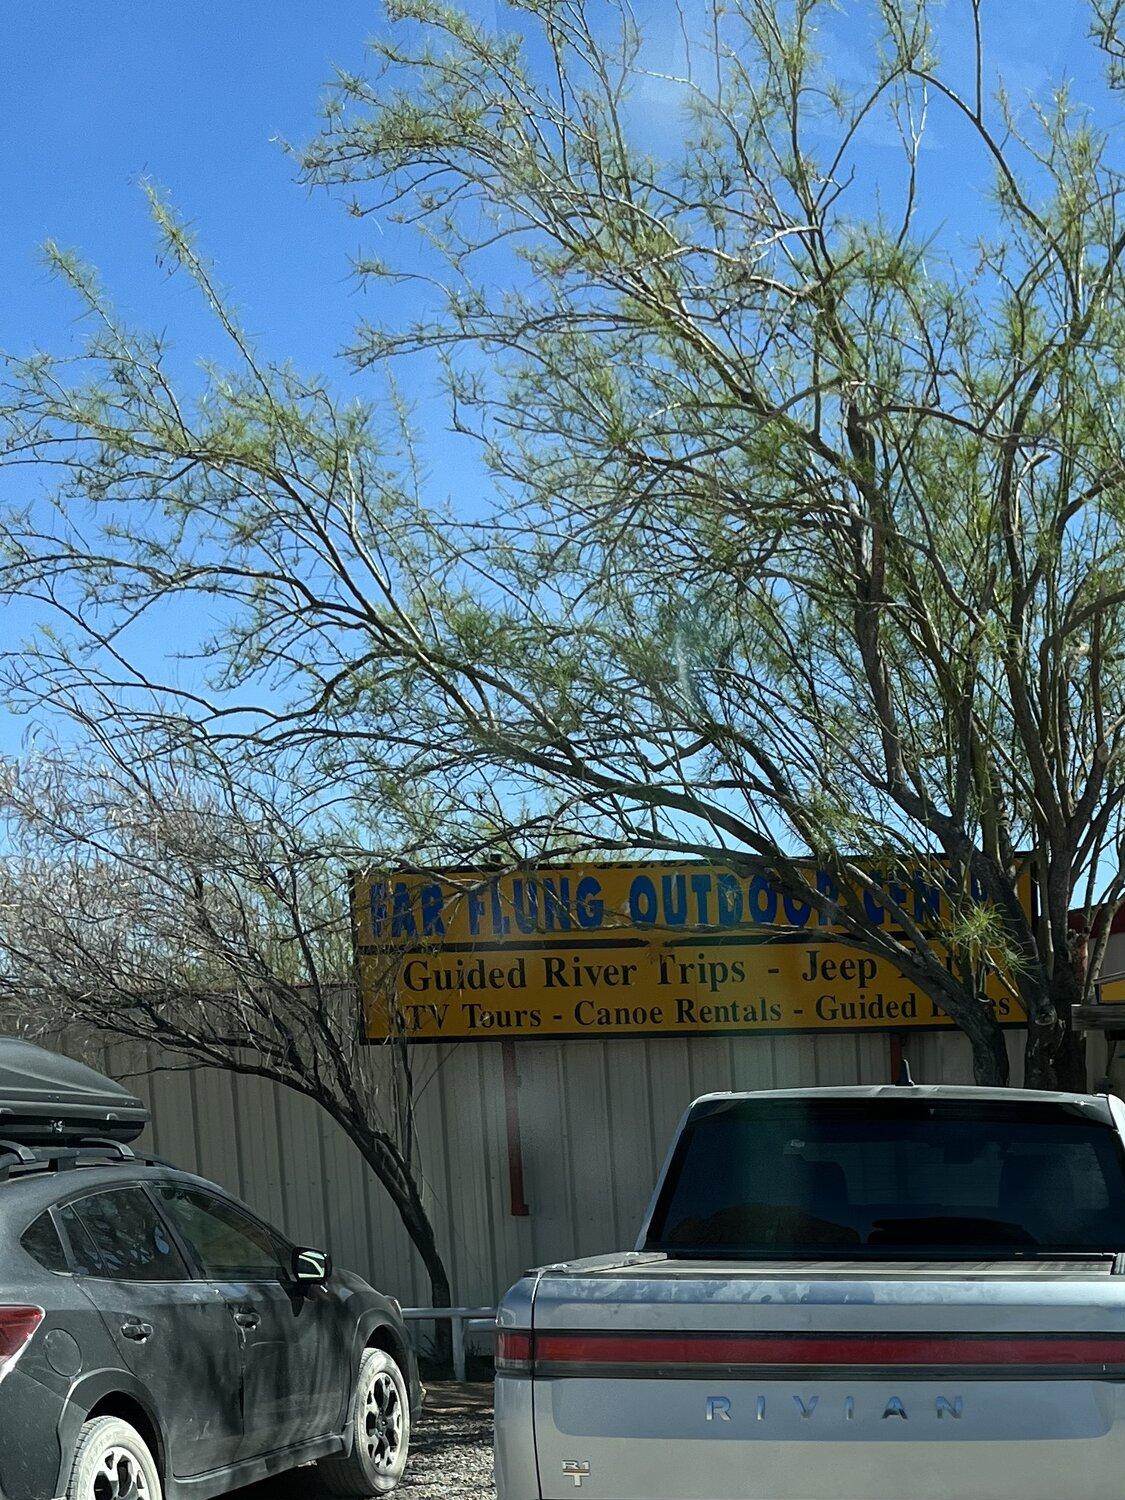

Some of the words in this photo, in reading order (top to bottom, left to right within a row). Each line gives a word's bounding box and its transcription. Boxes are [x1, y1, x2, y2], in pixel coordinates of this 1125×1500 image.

[370, 882, 446, 938] FAR
[467, 875, 604, 936] FLUNG
[403, 957, 527, 992] Guided
[542, 956, 637, 989] River
[657, 953, 746, 992] Trips
[803, 950, 878, 989] Jeep
[461, 1002, 541, 1029] Tours
[574, 1000, 663, 1027] Canoe
[675, 998, 782, 1024] Rentals
[815, 993, 917, 1022] Guided
[705, 1395, 964, 1422] RIVIAN
